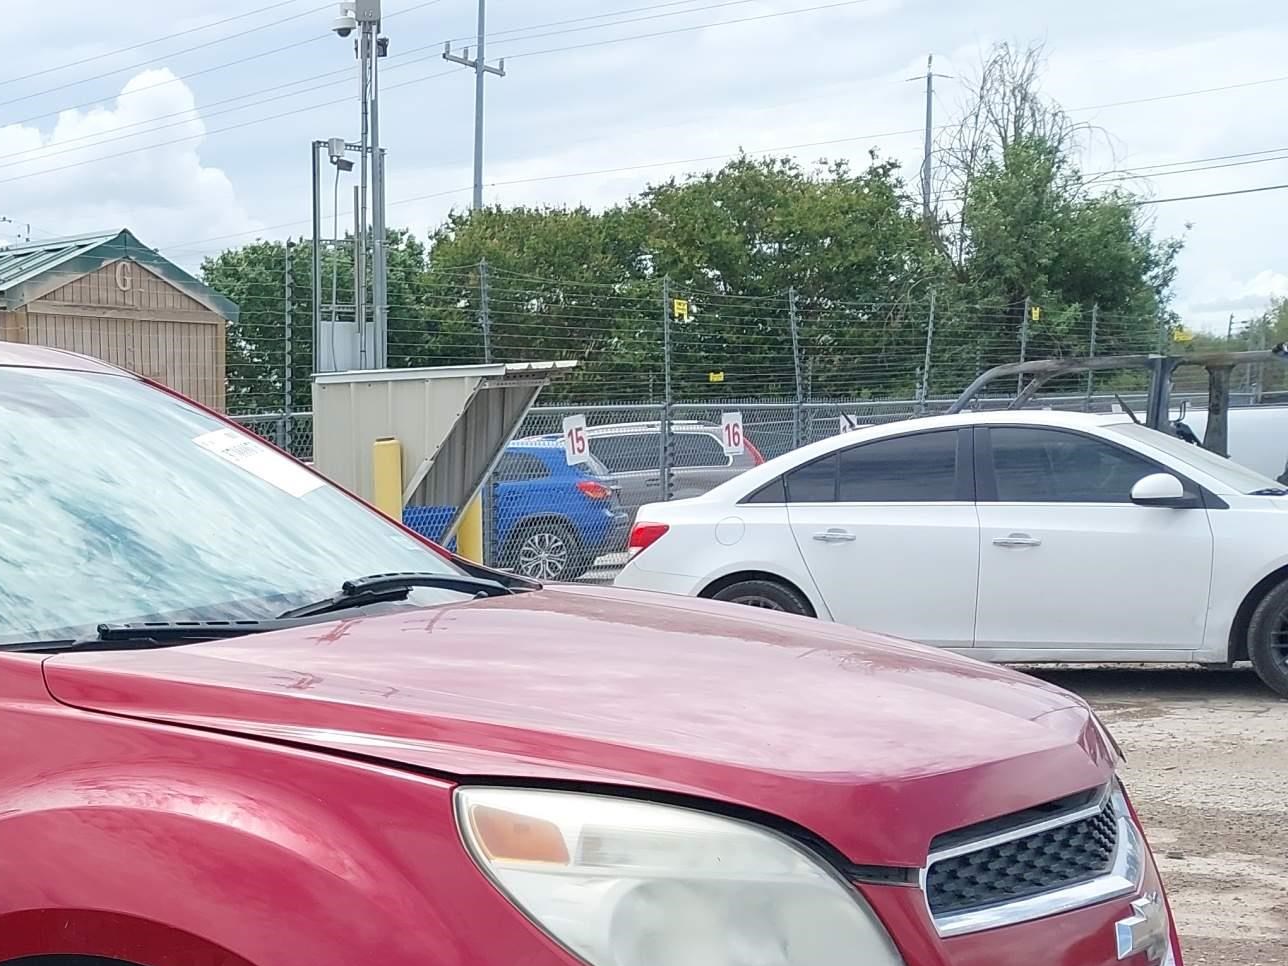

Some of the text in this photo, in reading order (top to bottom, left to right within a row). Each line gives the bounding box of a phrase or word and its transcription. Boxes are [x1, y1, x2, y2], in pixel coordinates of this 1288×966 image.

[115, 261, 131, 291] G
[567, 427, 586, 455] 15
[724, 422, 741, 447] 16
